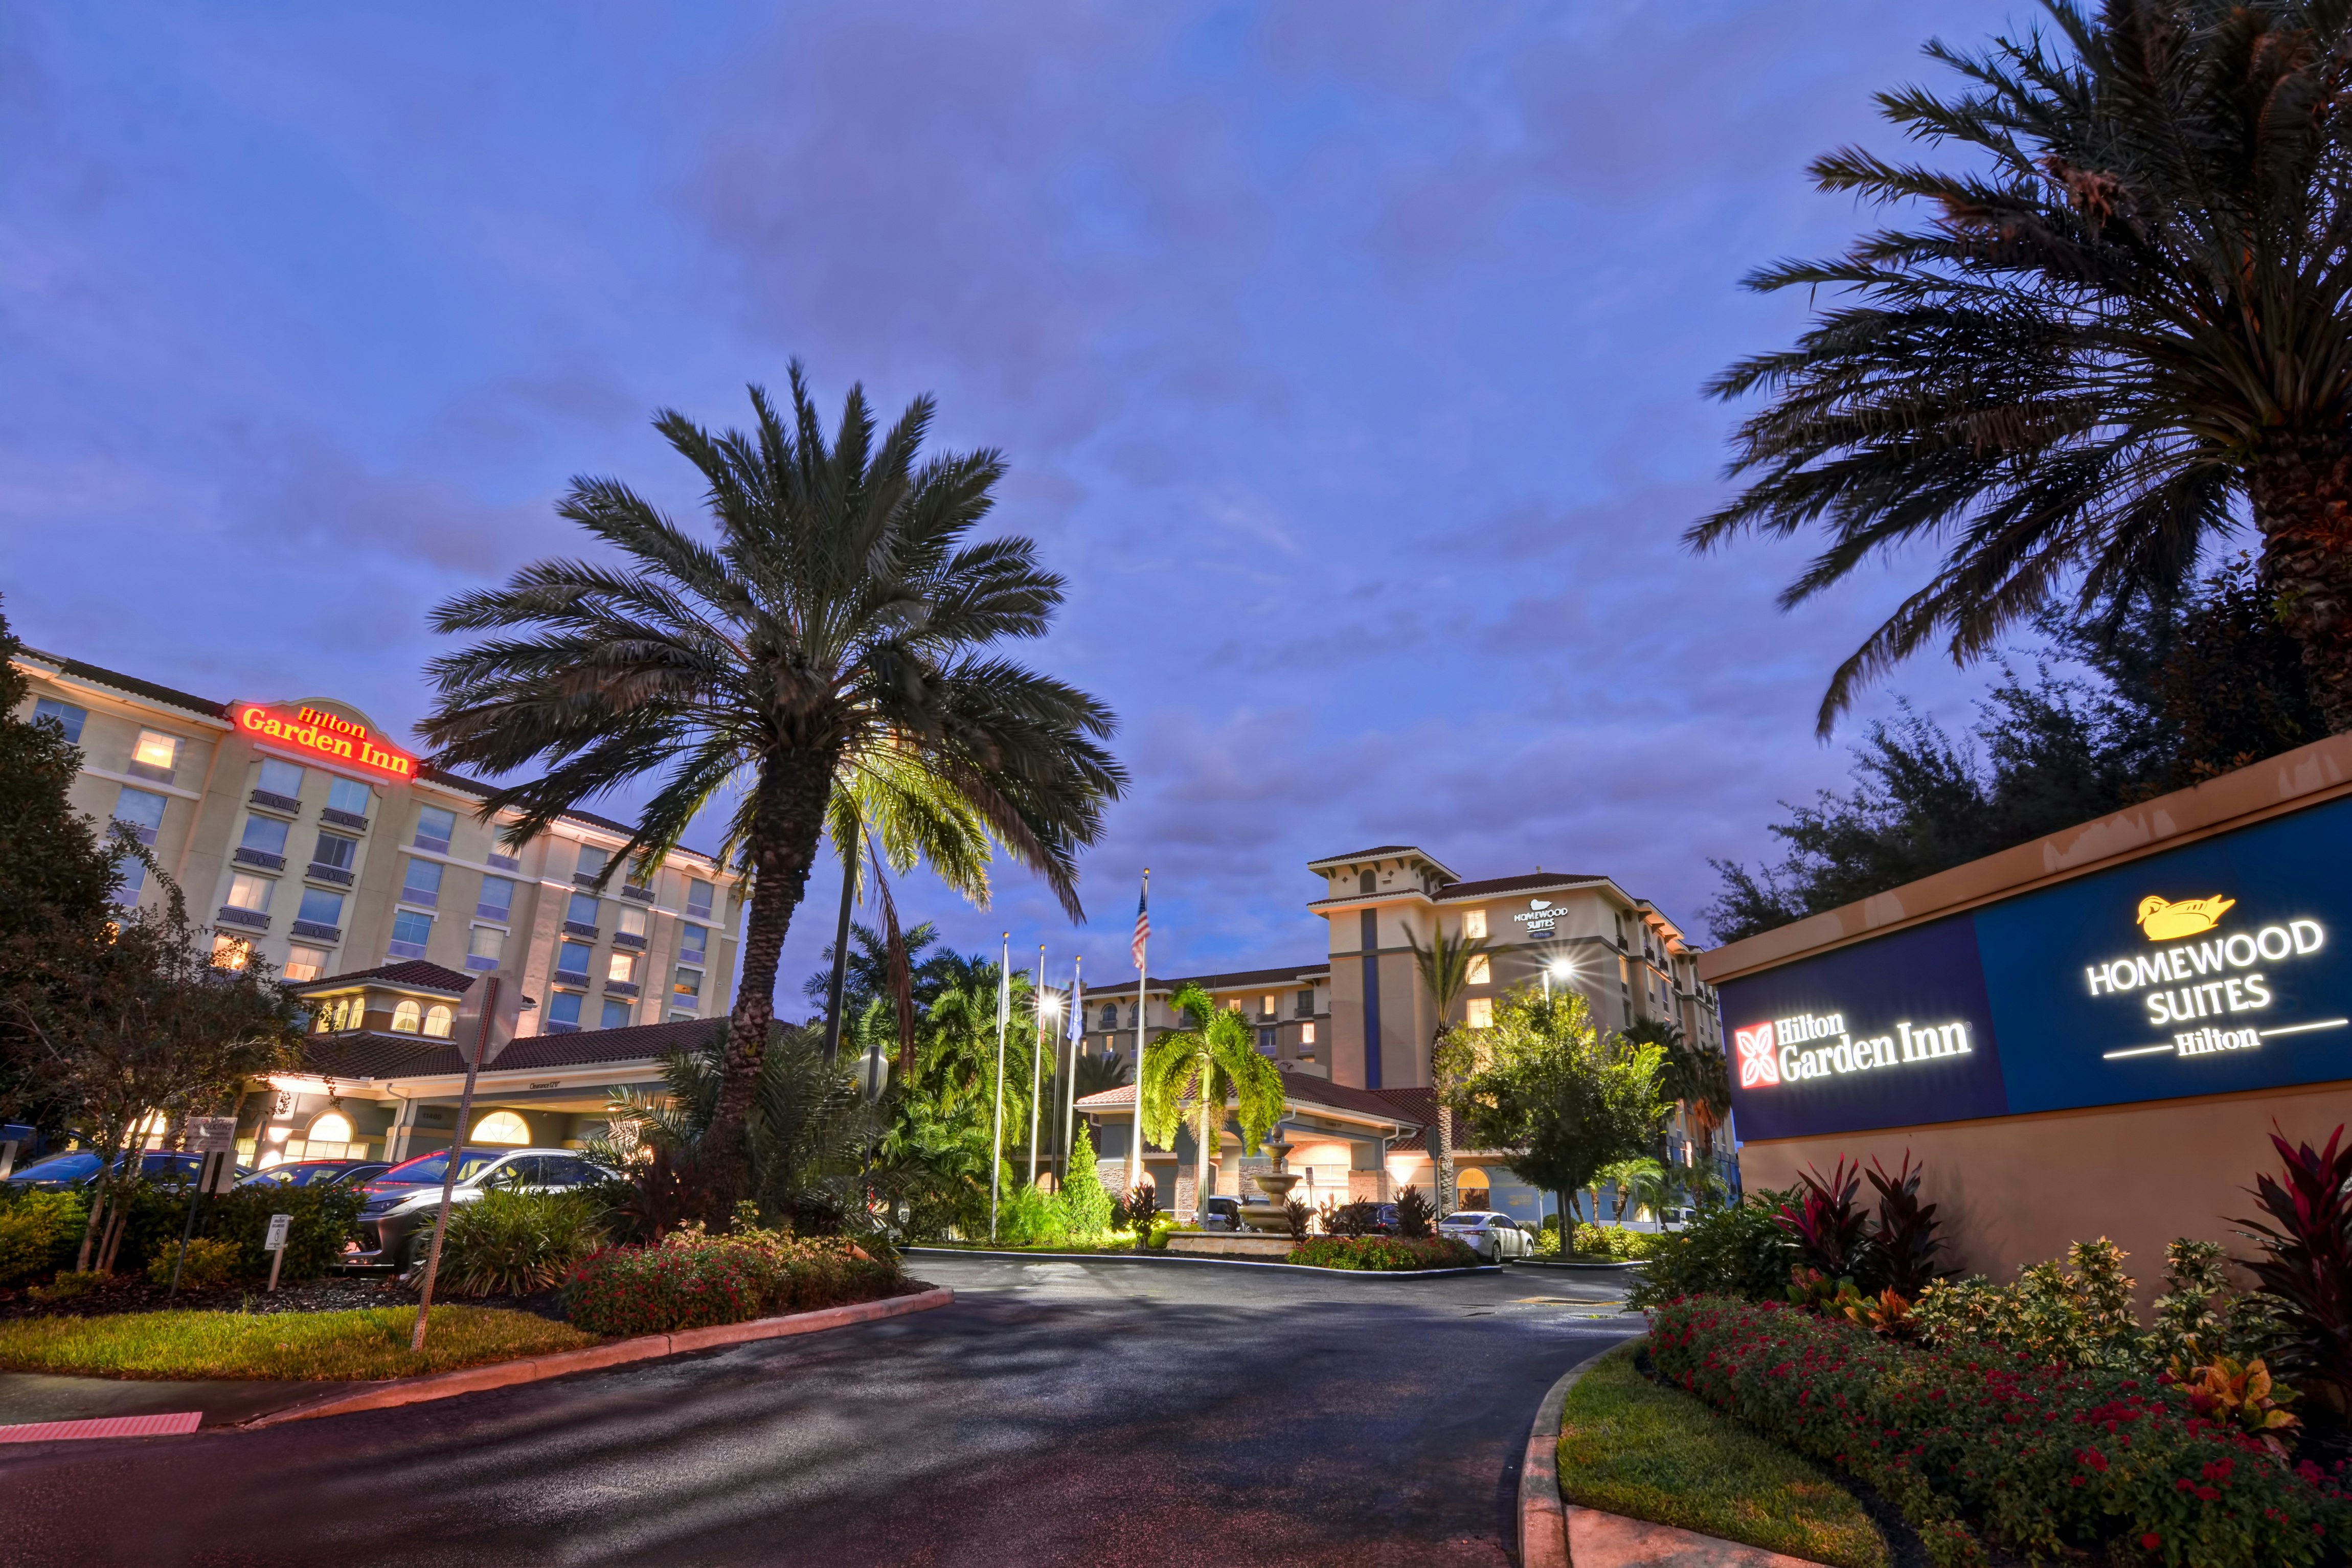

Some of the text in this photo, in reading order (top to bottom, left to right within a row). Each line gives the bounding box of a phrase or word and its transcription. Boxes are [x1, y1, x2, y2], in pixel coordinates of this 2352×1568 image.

[298, 707, 367, 739] Hilton
[243, 708, 408, 774] Garden Inn
[1514, 907, 1568, 922] HOMEWOOD
[1527, 918, 1555, 929] SUITES
[2087, 920, 2324, 995] HOMEWOOD
[2147, 974, 2271, 1025] SUITES
[1775, 1013, 1846, 1046] Hilton
[2174, 1028, 2261, 1056] Hilton
[1779, 1034, 1898, 1082] Garden
